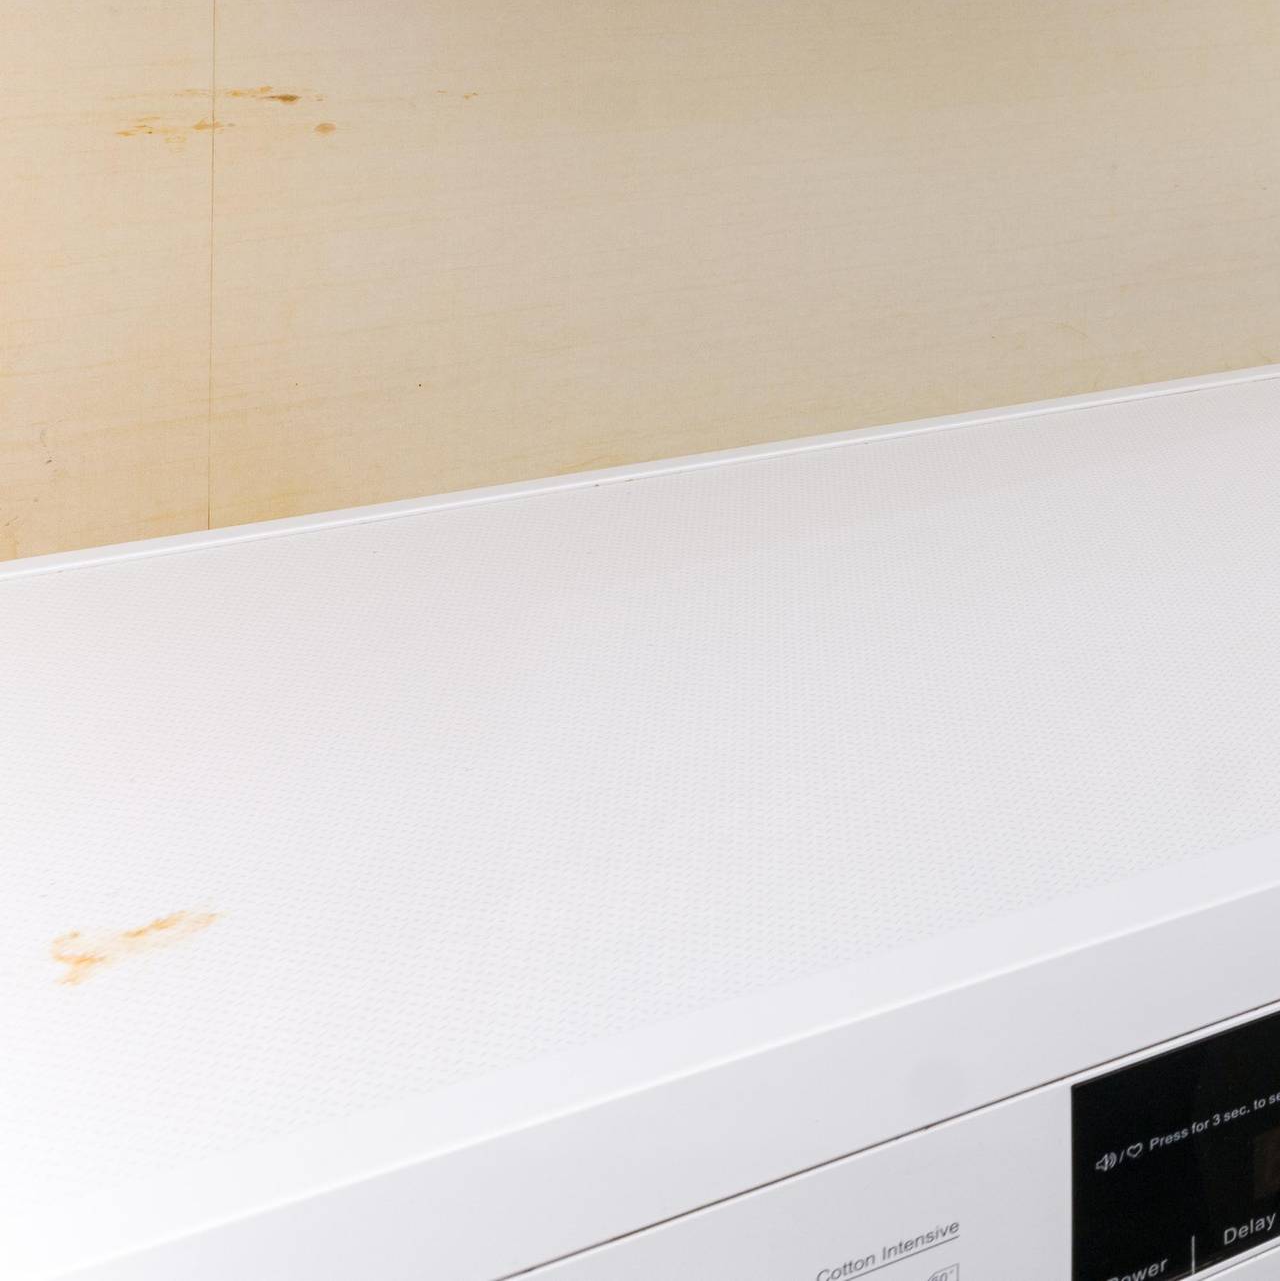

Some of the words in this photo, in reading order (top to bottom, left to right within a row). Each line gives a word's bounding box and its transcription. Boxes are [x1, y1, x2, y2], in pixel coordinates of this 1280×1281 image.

[1149, 1127, 1189, 1151] Press
[1191, 1118, 1210, 1135] for
[1212, 1113, 1222, 1127] 3
[1223, 1106, 1250, 1126] sec.
[1253, 1097, 1266, 1111] to
[816, 1253, 876, 1281] Cotton
[882, 1221, 960, 1261] Intensive
[1223, 1212, 1277, 1246] Delay
